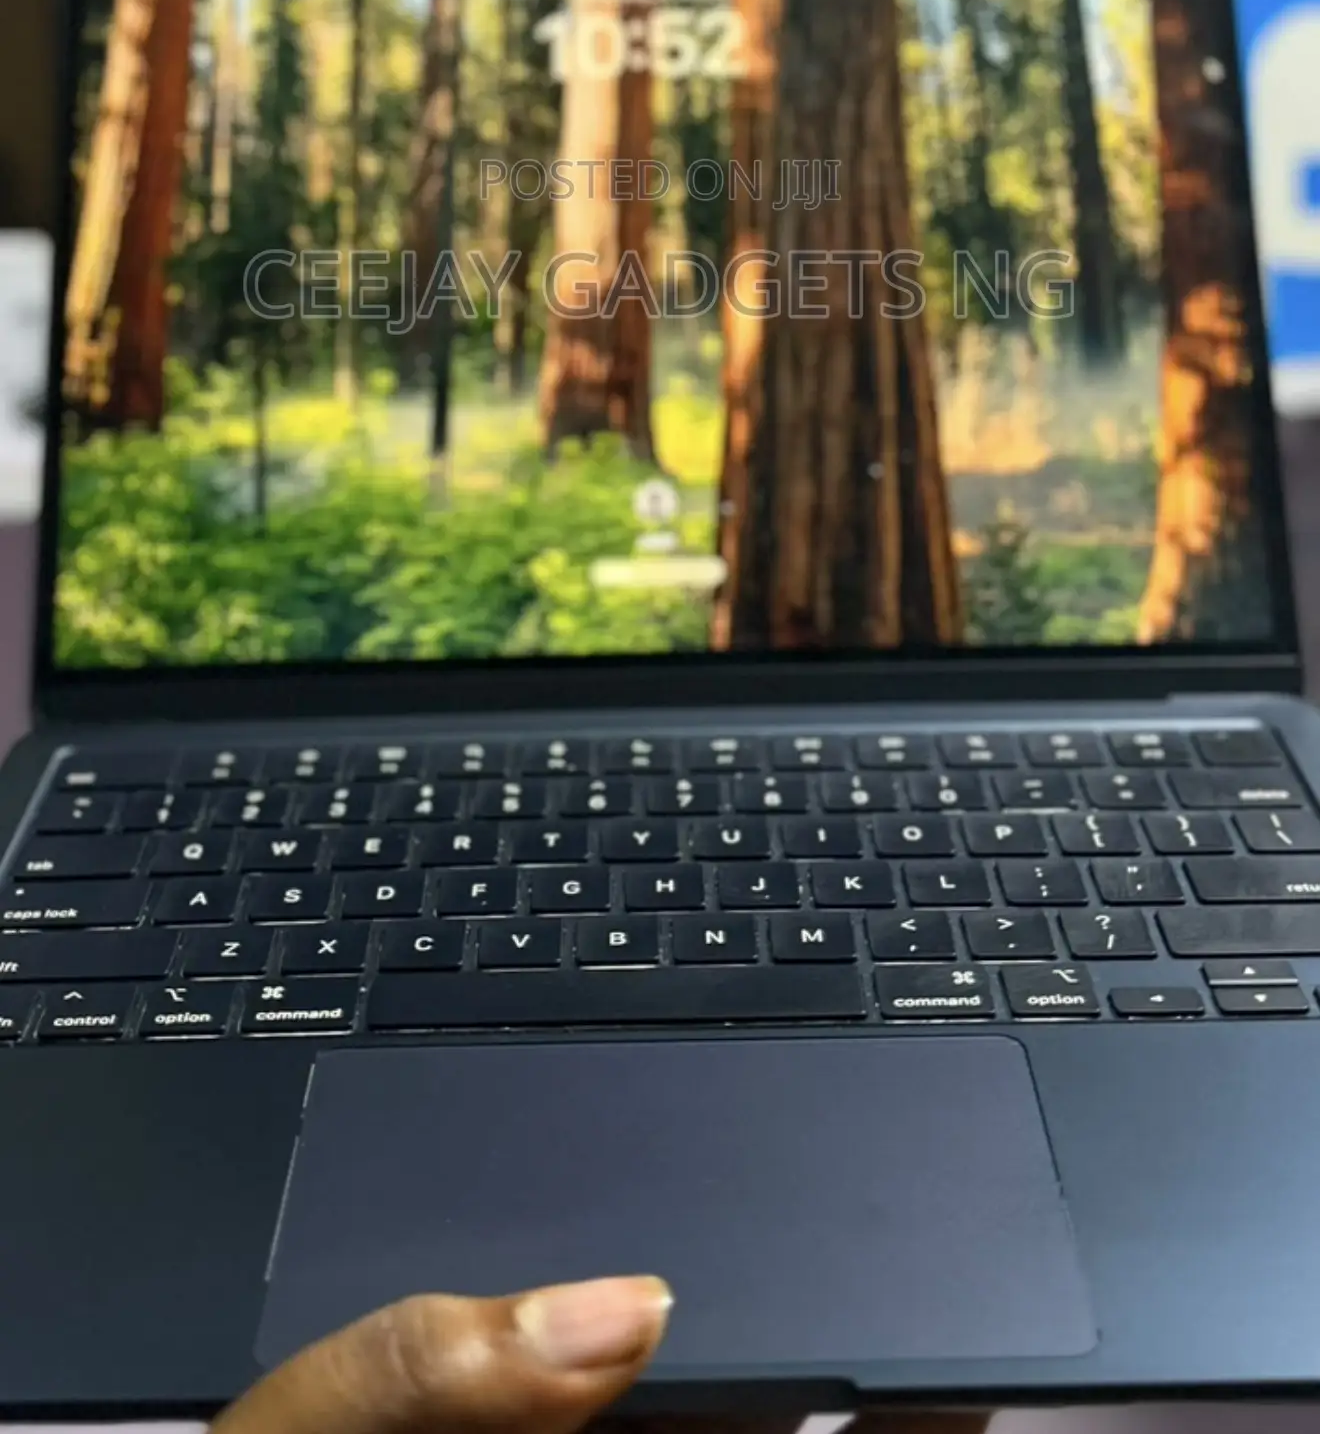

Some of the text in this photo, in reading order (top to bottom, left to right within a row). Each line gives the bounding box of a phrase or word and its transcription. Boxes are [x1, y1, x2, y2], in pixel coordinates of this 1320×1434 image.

[533, 8, 747, 84] 10:52
[543, 832, 560, 847] T
[633, 831, 650, 845] Y
[721, 829, 741, 844] U
[817, 828, 826, 842] I
[902, 826, 923, 841] O
[994, 825, 1013, 840] P
[271, 841, 297, 856] W
[364, 838, 381, 853] E
[453, 835, 471, 850] R
[183, 843, 204, 860] Q
[26, 860, 54, 871] tab
[562, 880, 581, 895] G
[655, 879, 675, 893] H
[751, 877, 766, 891] J
[844, 876, 862, 890] K
[939, 875, 956, 889] L
[283, 888, 302, 903] S
[376, 885, 396, 900] D
[471, 883, 487, 897] F
[189, 891, 208, 906] A
[3, 908, 78, 920] caps lock
[511, 933, 530, 949] V
[609, 931, 628, 946] B
[705, 930, 725, 945] N
[800, 928, 824, 943] M
[220, 941, 241, 957] Z
[317, 939, 337, 954] X
[414, 936, 434, 952] C
[0, 961, 19, 973] ift
[893, 995, 982, 1008] command
[1026, 993, 1085, 1007] option
[53, 1014, 116, 1027] control
[154, 1011, 212, 1025] option
[255, 1007, 343, 1021] command
